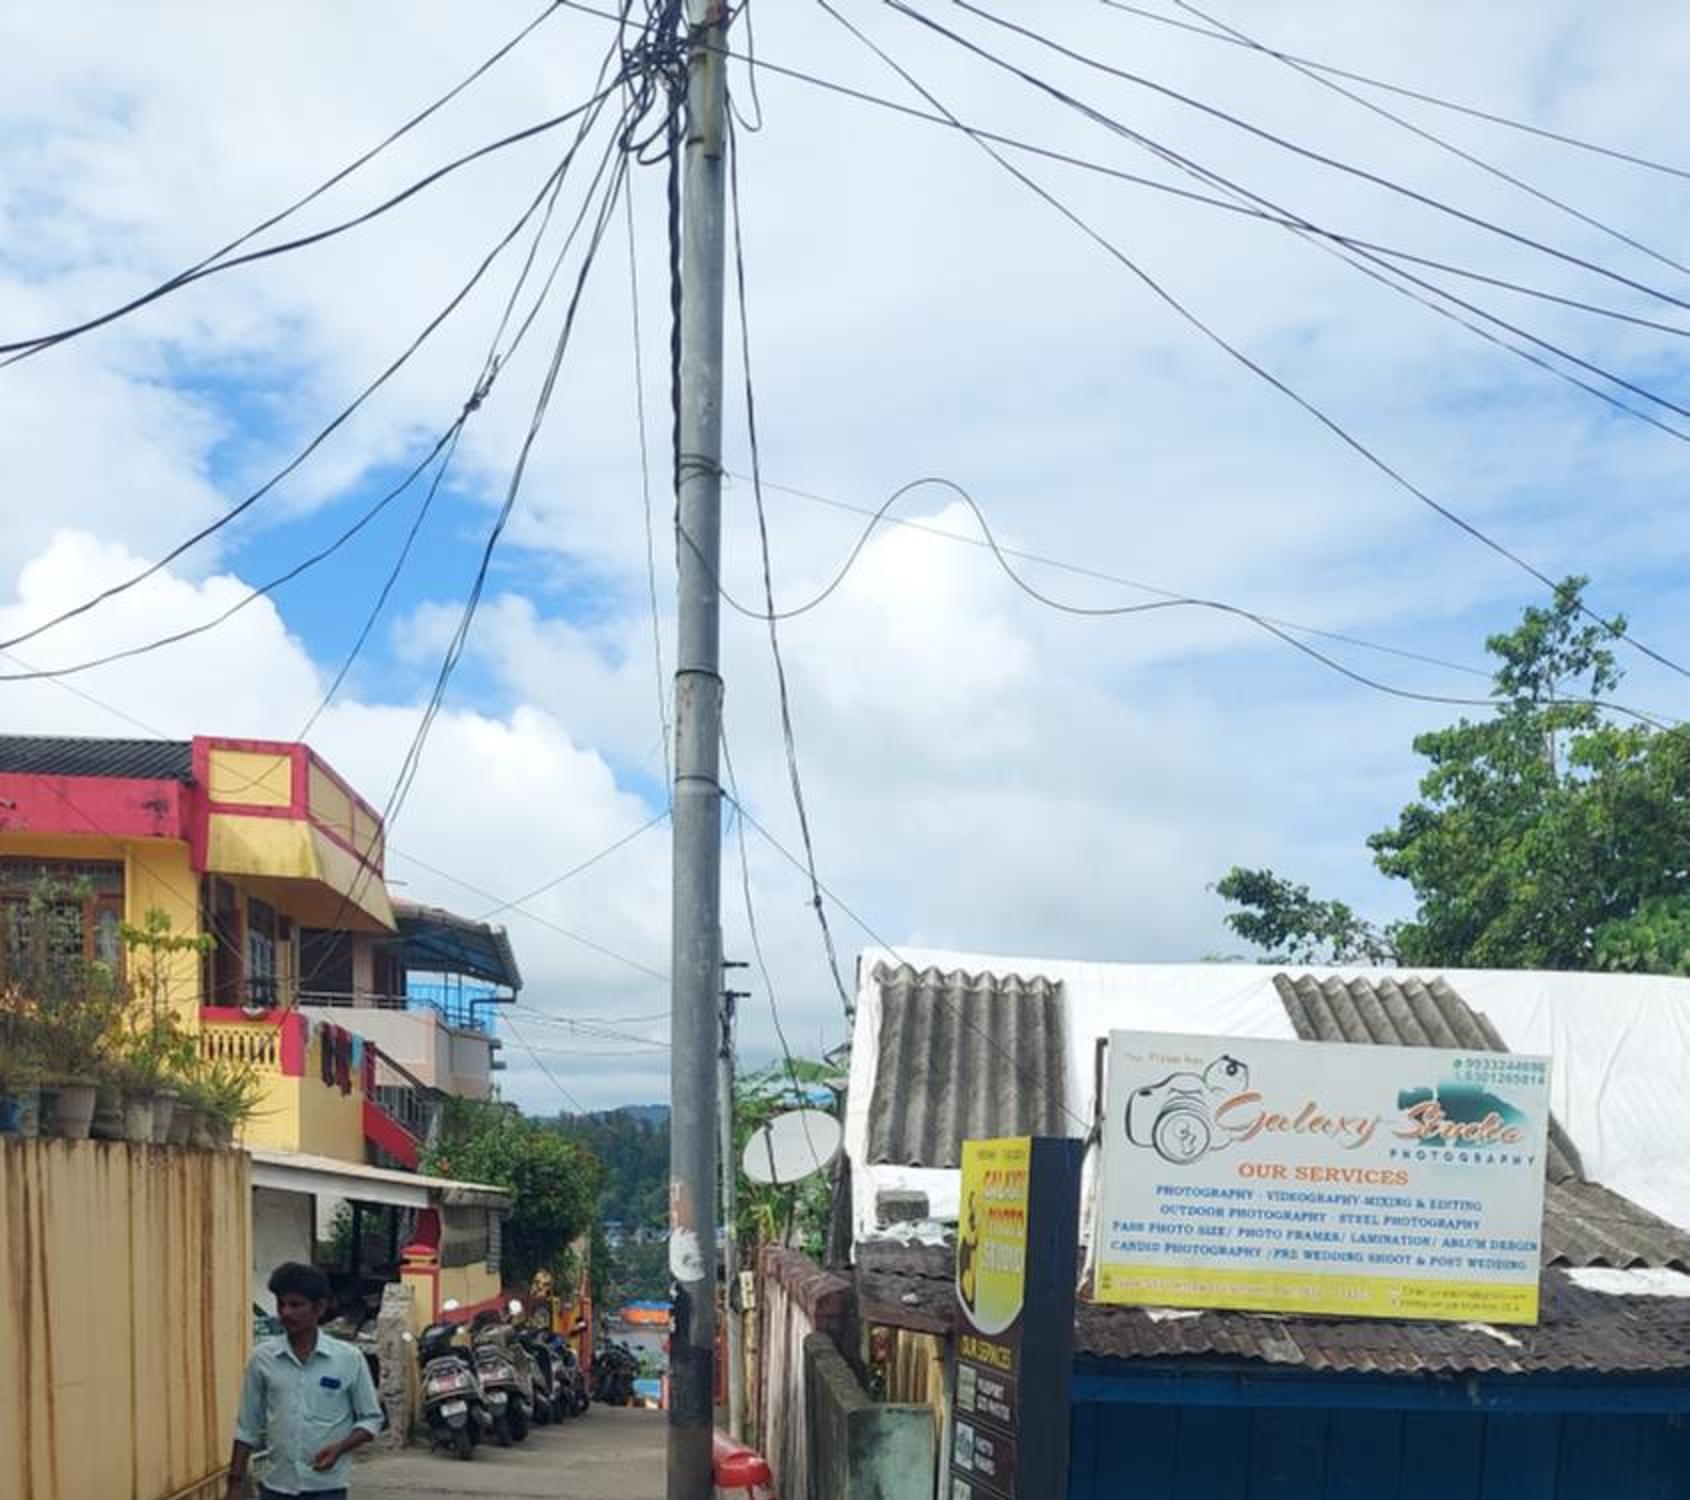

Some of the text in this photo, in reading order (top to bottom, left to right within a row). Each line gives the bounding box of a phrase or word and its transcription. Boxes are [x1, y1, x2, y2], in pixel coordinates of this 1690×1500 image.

[1215, 1090, 1380, 1150] Galaxy
[1390, 1149, 1536, 1166] PHOTOGRAPHY
[1238, 1163, 1409, 1185] OUR SERVICES
[1156, 1185, 1254, 1200] PHOTOGRAPHY
[1267, 1190, 1360, 1206] VIDEOGRAPHY
[1364, 1196, 1412, 1208] MIXING
[1430, 1200, 1482, 1212] EDITING
[1160, 1204, 1480, 1230] OUTDOOR PHOTOGRAPHY STEEL PHOTOGRAPHY
[1150, 1223, 1194, 1235] PHOTO
[1238, 1228, 1282, 1240] PHOTO
[1165, 1241, 1261, 1257] PHOTOGRAPHY
[1304, 1249, 1363, 1263] WEDDING
[1368, 1252, 1412, 1265] SHOOT
[1429, 1255, 1463, 1268] POST
[1468, 1257, 1528, 1271] WEDDING
